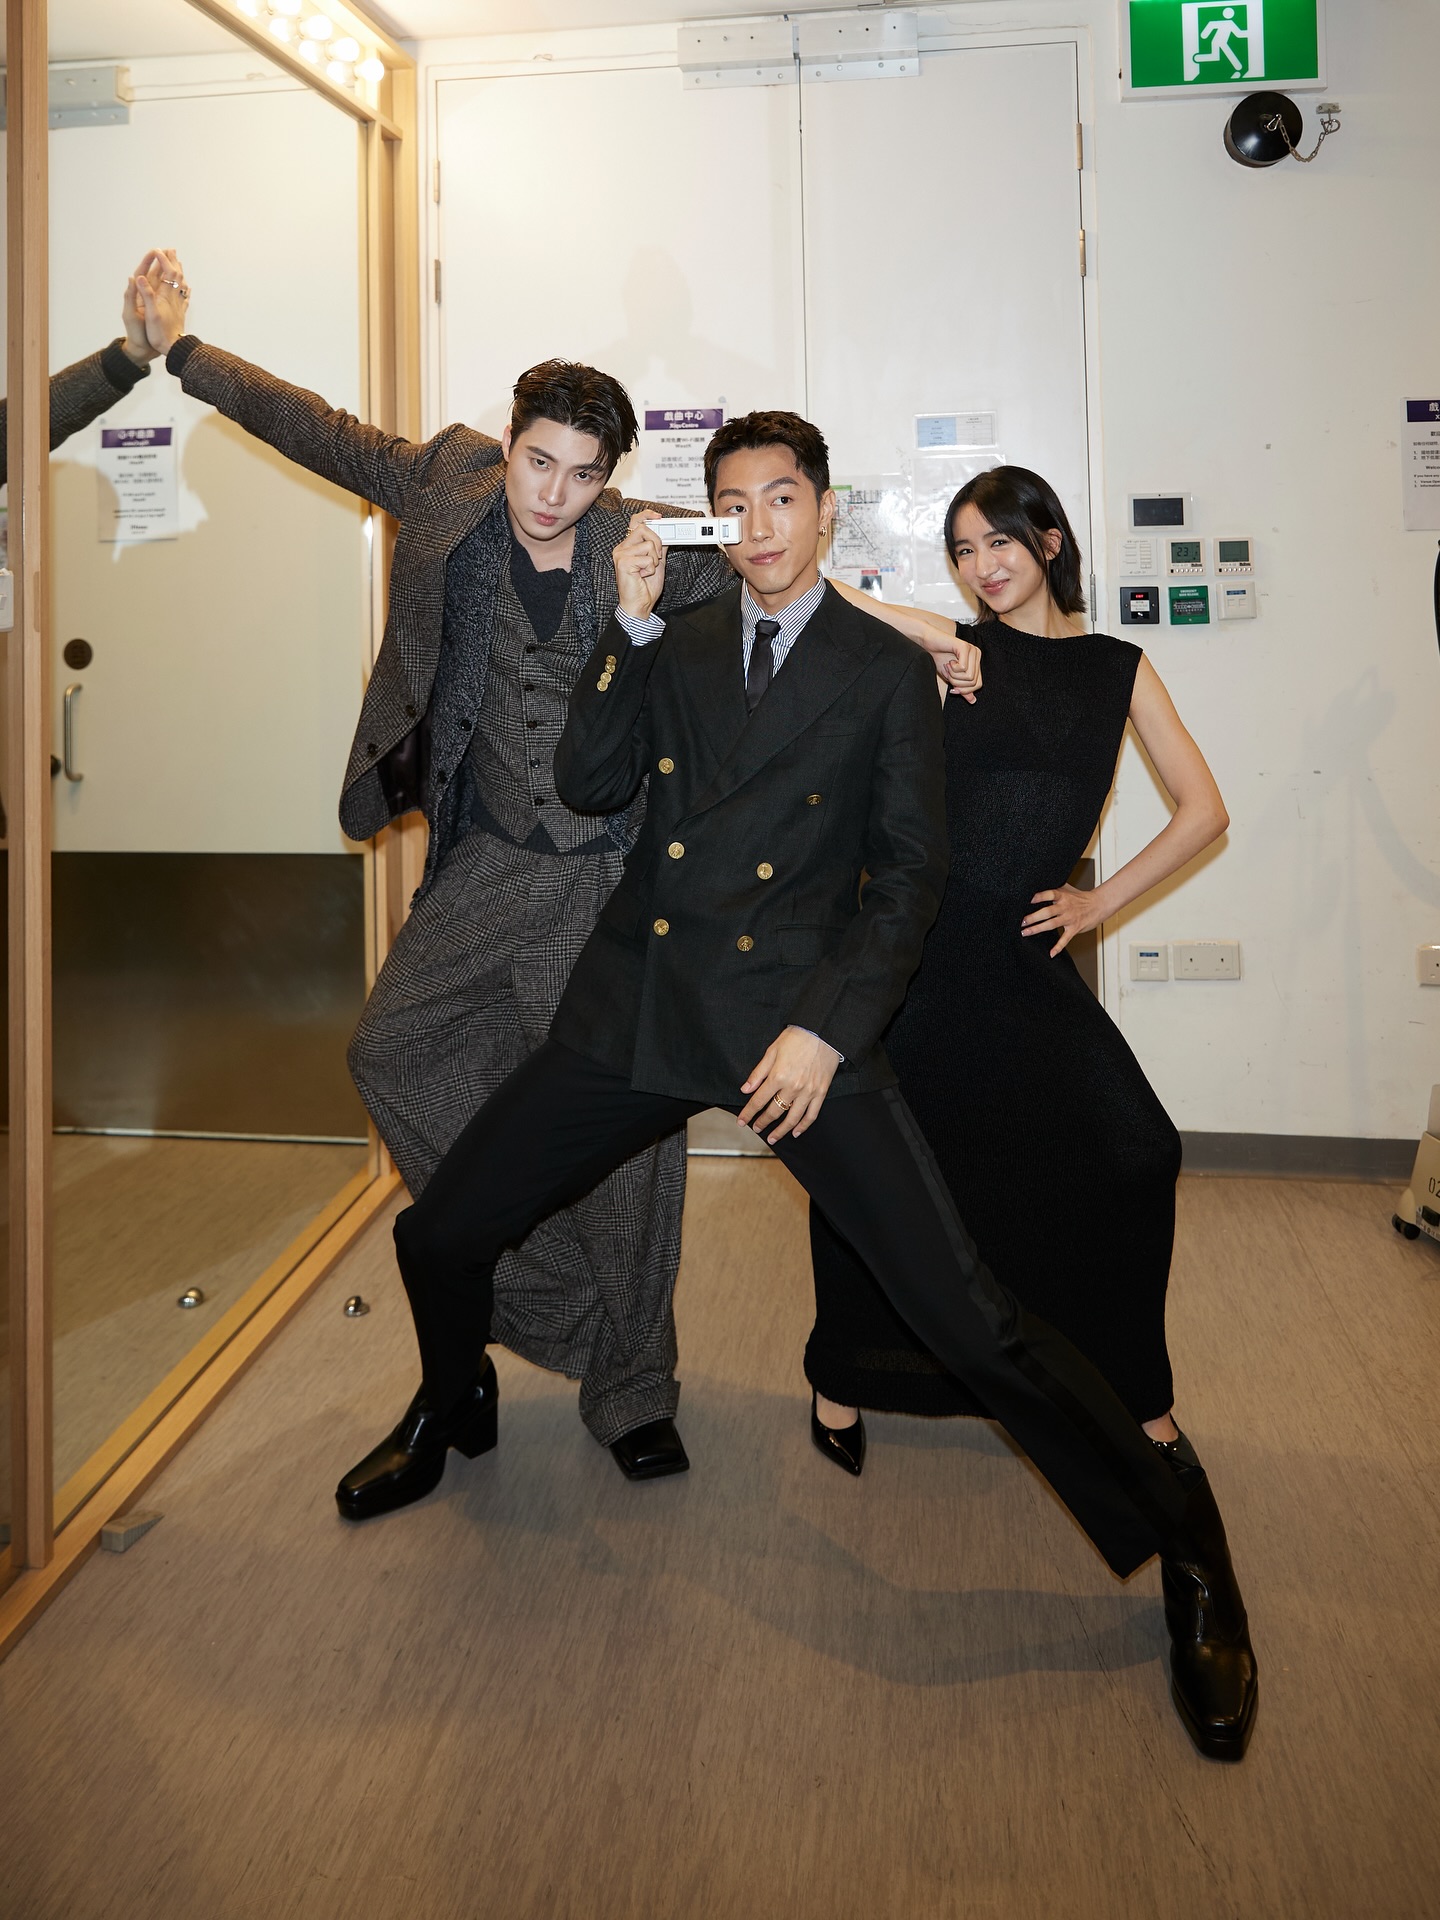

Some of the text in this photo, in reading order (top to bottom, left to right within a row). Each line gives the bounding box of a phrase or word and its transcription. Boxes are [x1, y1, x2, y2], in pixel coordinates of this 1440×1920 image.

[664, 411, 704, 421] 戲曲中心
[1177, 547, 1189, 557] 23
